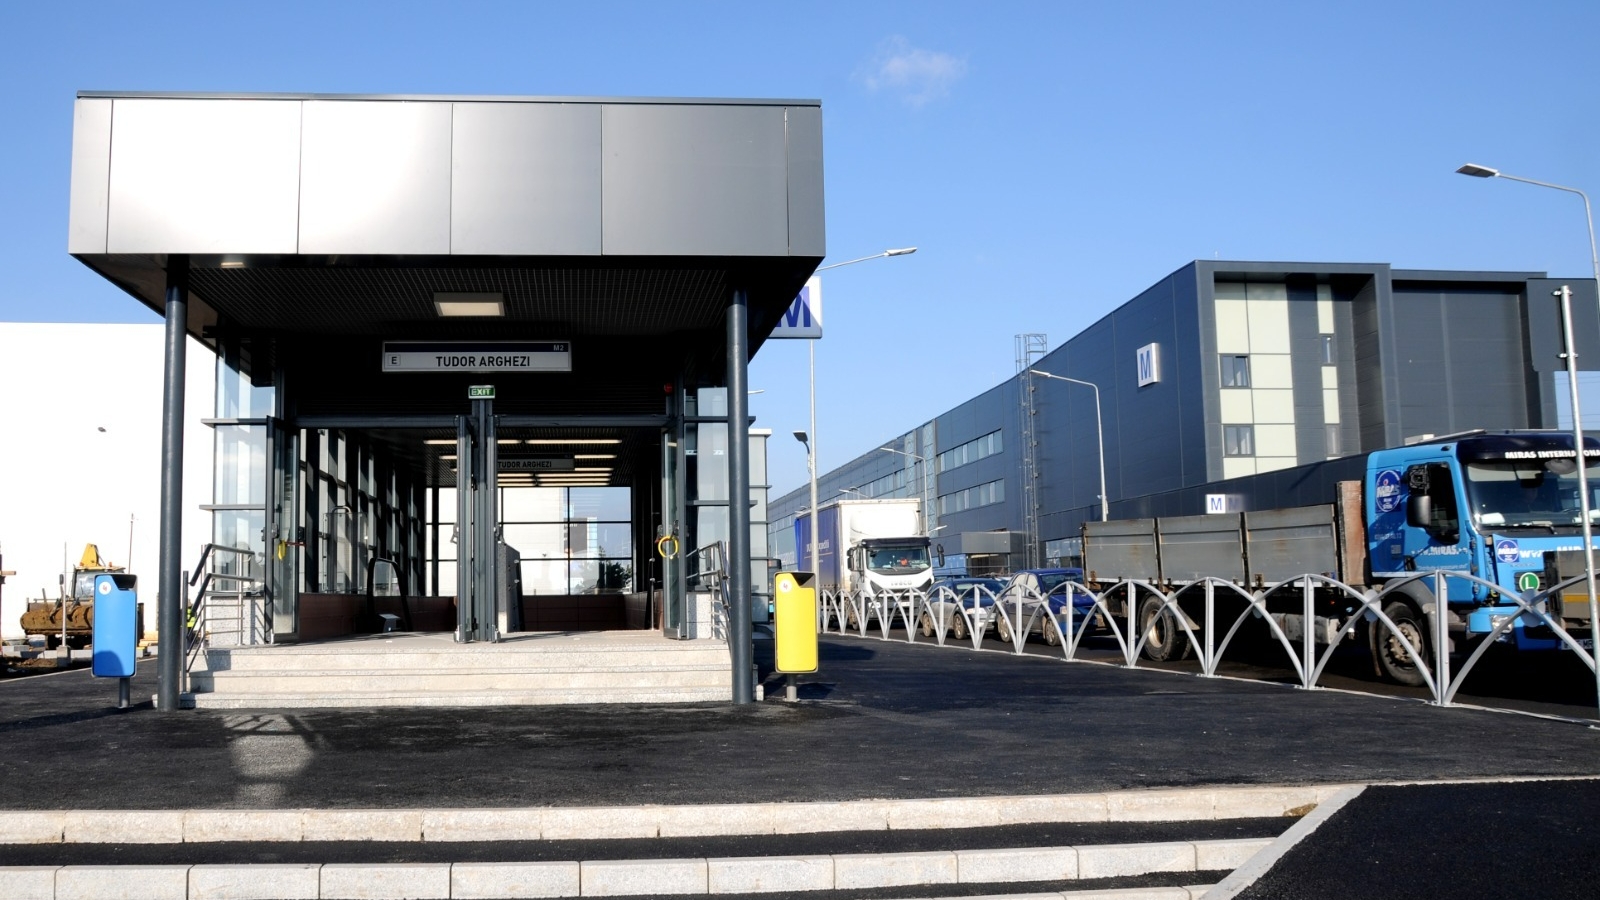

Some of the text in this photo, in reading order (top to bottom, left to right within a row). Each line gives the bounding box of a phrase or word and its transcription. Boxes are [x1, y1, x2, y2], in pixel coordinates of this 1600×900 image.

[391, 356, 397, 365] E
[436, 356, 530, 367] TUDOR ARGHEZI
[1140, 350, 1152, 380] M
[471, 388, 492, 396] EXIT
[1505, 450, 1600, 459] MIRAS INTERNAONA
[1210, 497, 1222, 511] M
[1525, 576, 1535, 589] L
